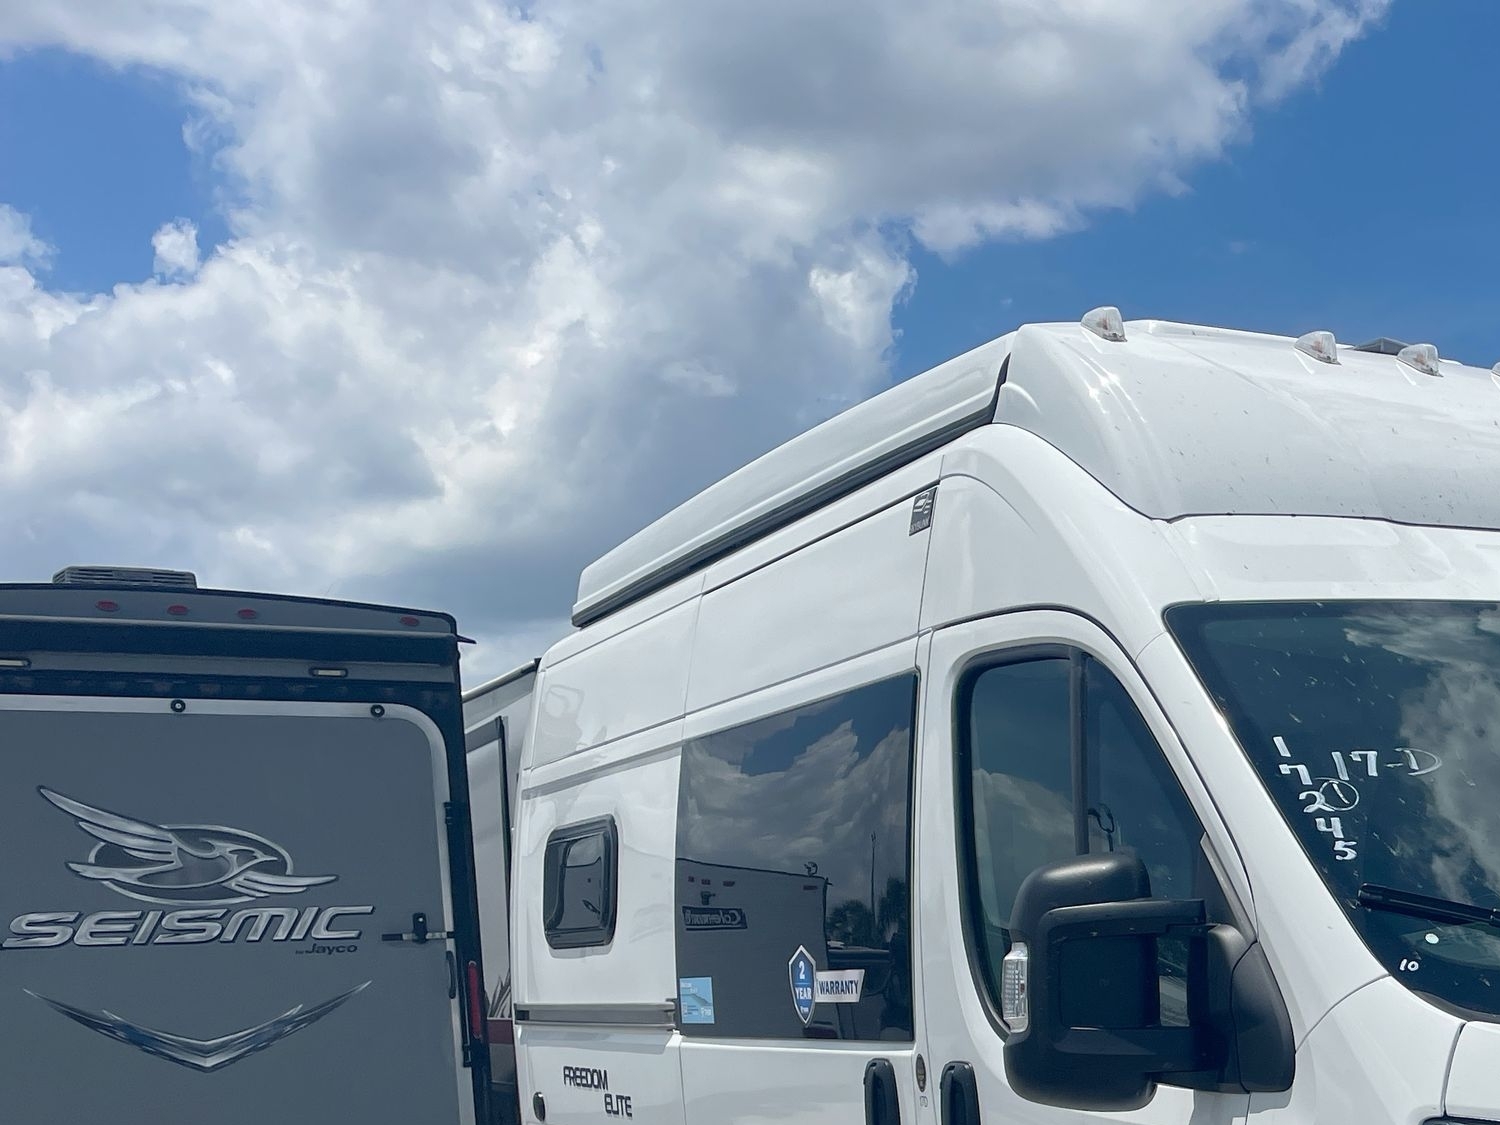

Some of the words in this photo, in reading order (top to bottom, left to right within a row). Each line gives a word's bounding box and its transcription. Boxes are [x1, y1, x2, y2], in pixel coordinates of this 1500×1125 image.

[0, 905, 376, 949] SEISMIC
[305, 942, 359, 955] Jayco
[798, 960, 806, 980] 2
[794, 986, 812, 1000] YEAR
[819, 980, 859, 995] WARRANTY
[563, 1065, 609, 1091] FREEDOM
[604, 1093, 633, 1118] ELITE
